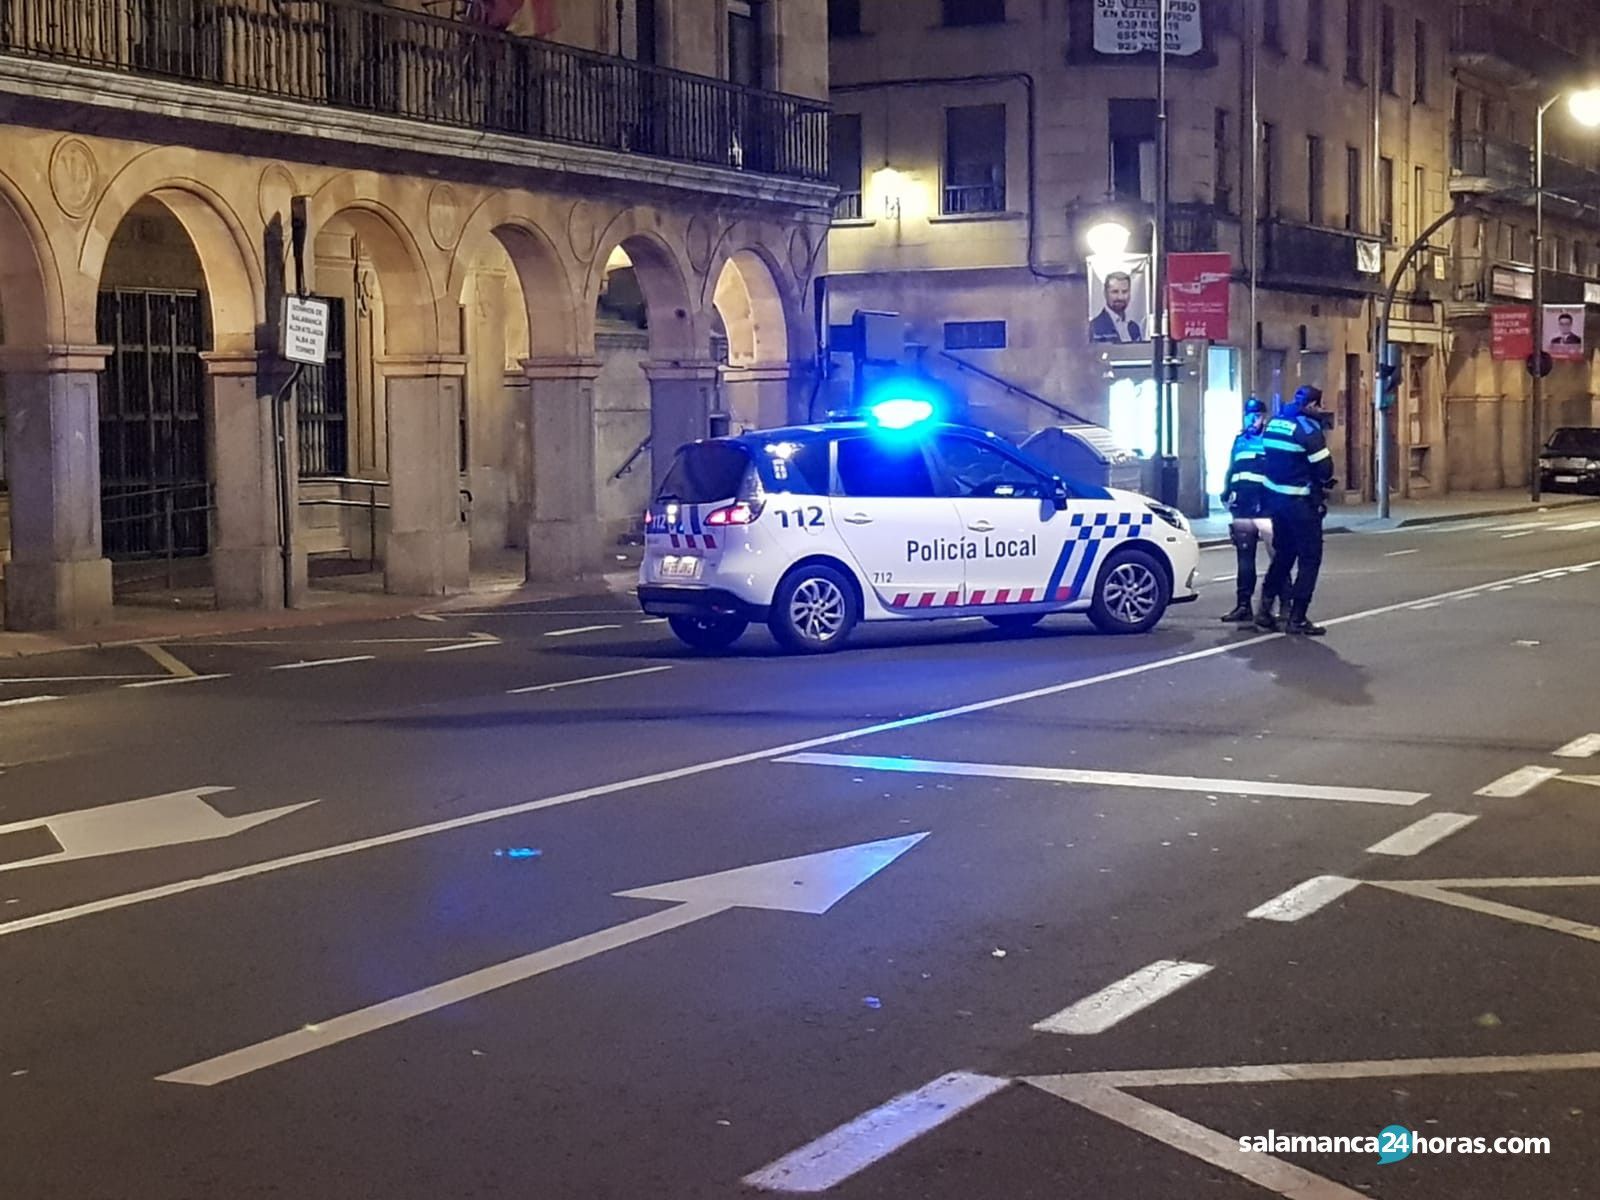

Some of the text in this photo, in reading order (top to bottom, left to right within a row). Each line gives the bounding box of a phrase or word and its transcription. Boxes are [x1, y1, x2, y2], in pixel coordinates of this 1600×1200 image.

[652, 514, 667, 530] 112
[774, 506, 825, 529] 112
[907, 534, 1036, 562] Policía Local
[873, 572, 893, 584] 712
